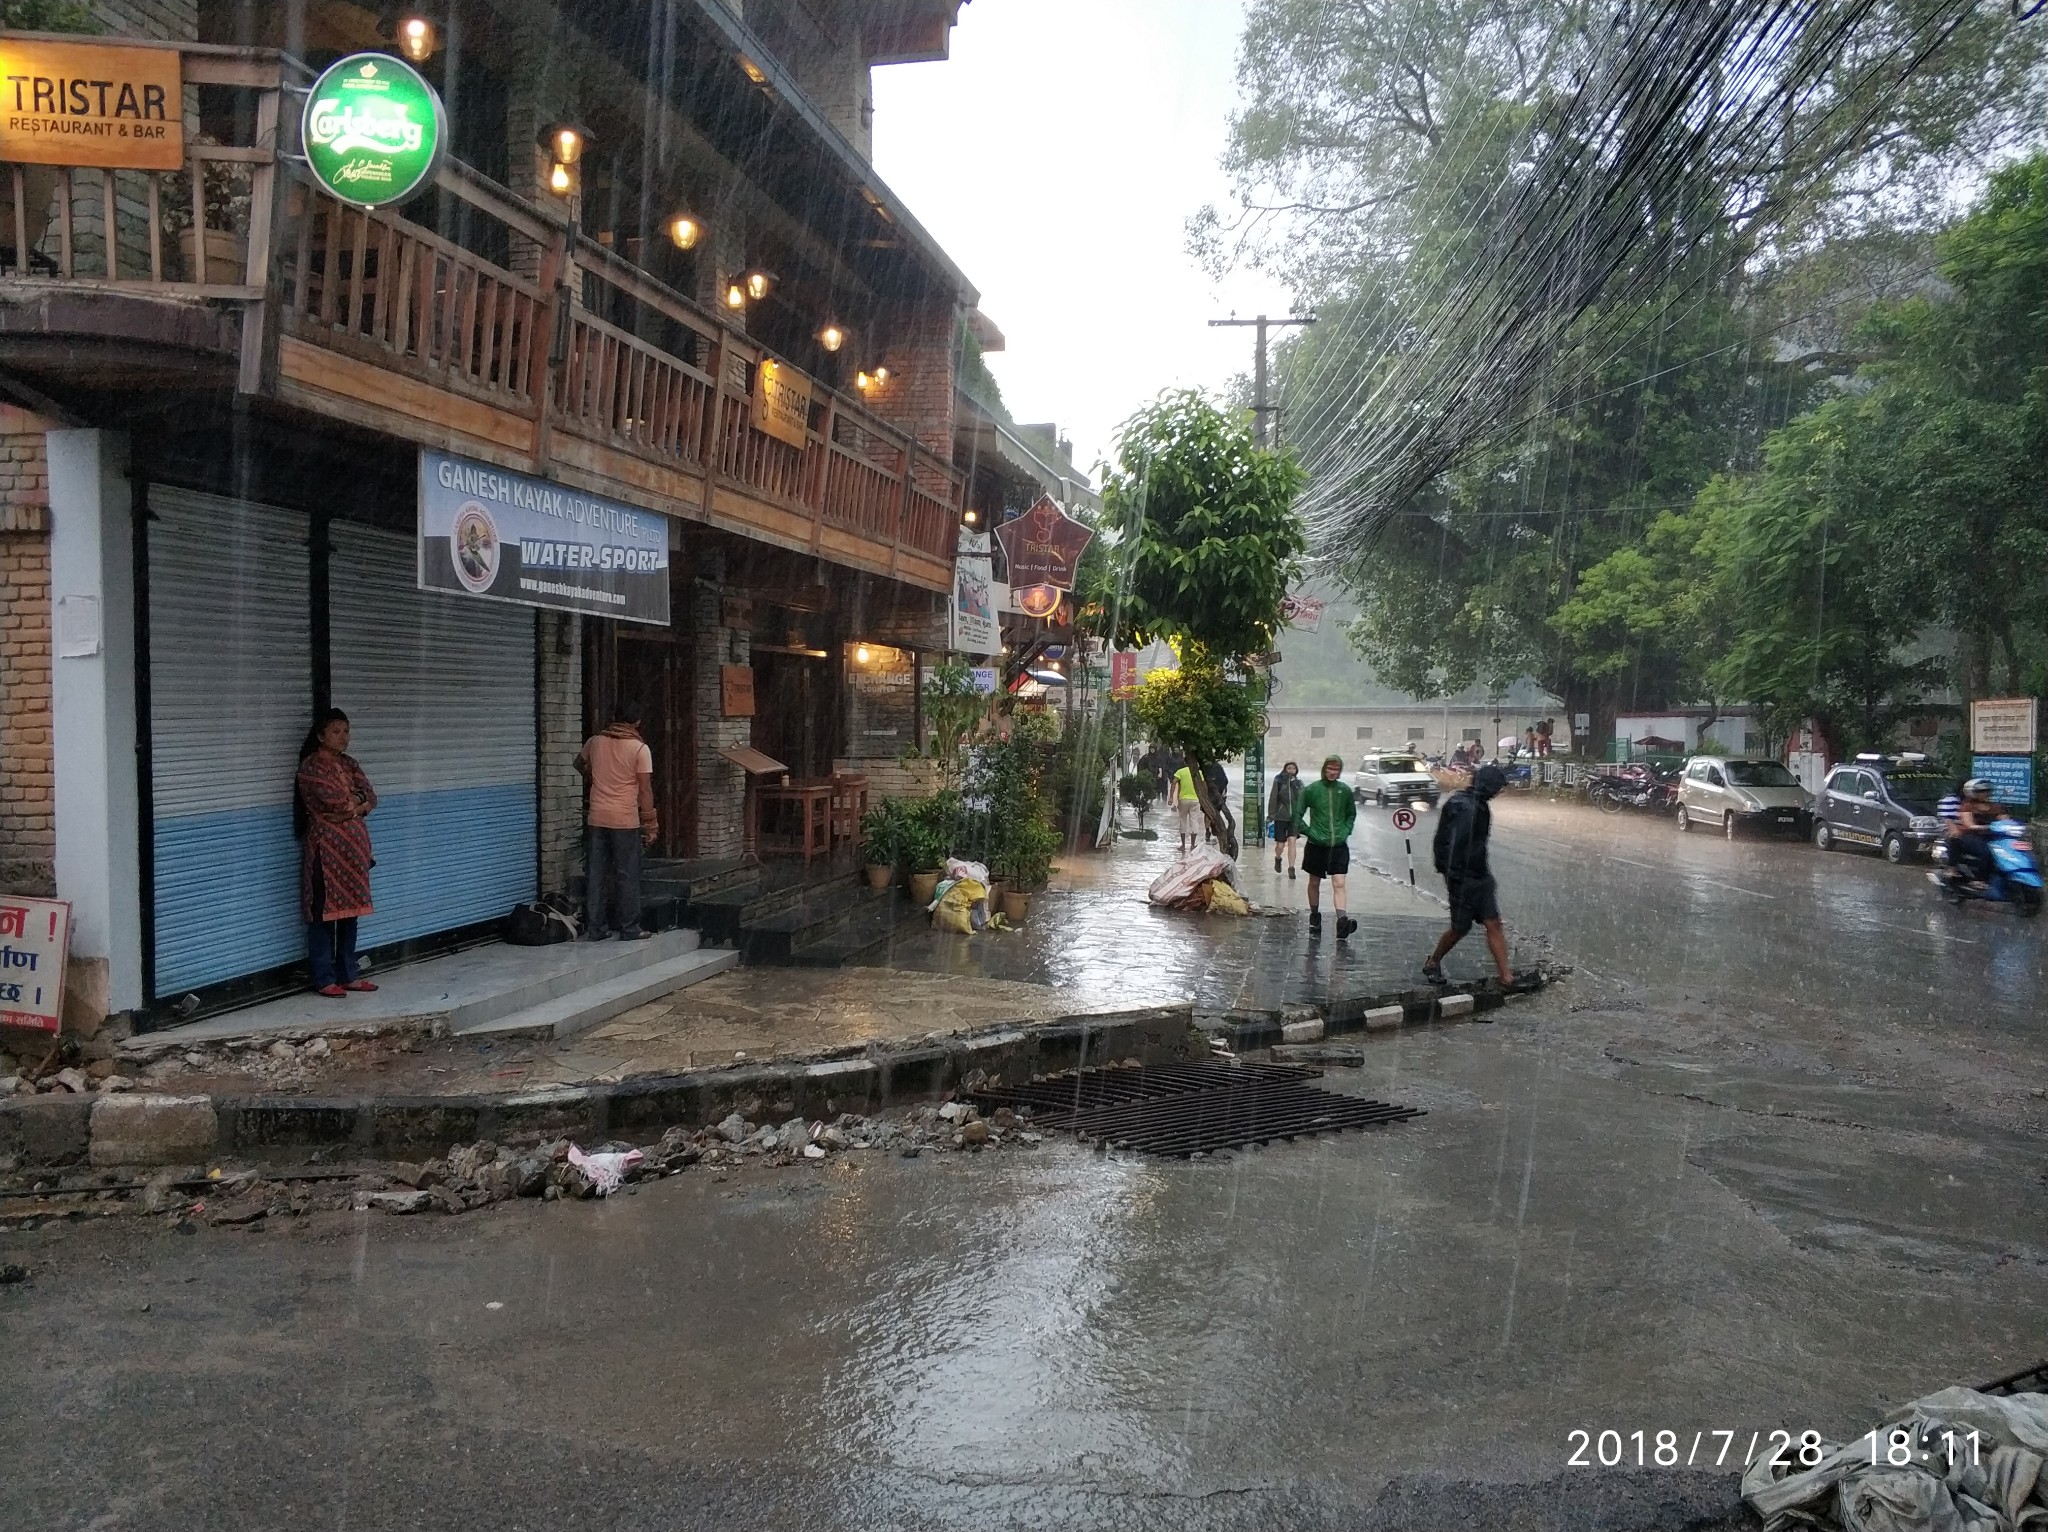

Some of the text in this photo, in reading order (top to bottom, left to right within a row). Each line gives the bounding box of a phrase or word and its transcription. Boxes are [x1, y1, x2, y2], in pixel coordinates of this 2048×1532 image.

[7, 75, 166, 121] TRISTAR
[9, 117, 166, 140] RESTAURANT & BAR
[310, 98, 424, 152] Carlsberg
[775, 380, 808, 420] TRISTAR
[438, 461, 510, 504] GANESH
[513, 482, 563, 518] KAYAK
[565, 498, 638, 538] ADVENTURE
[521, 540, 658, 571] WATER SPORT
[1025, 543, 1060, 554] TRISTAR
